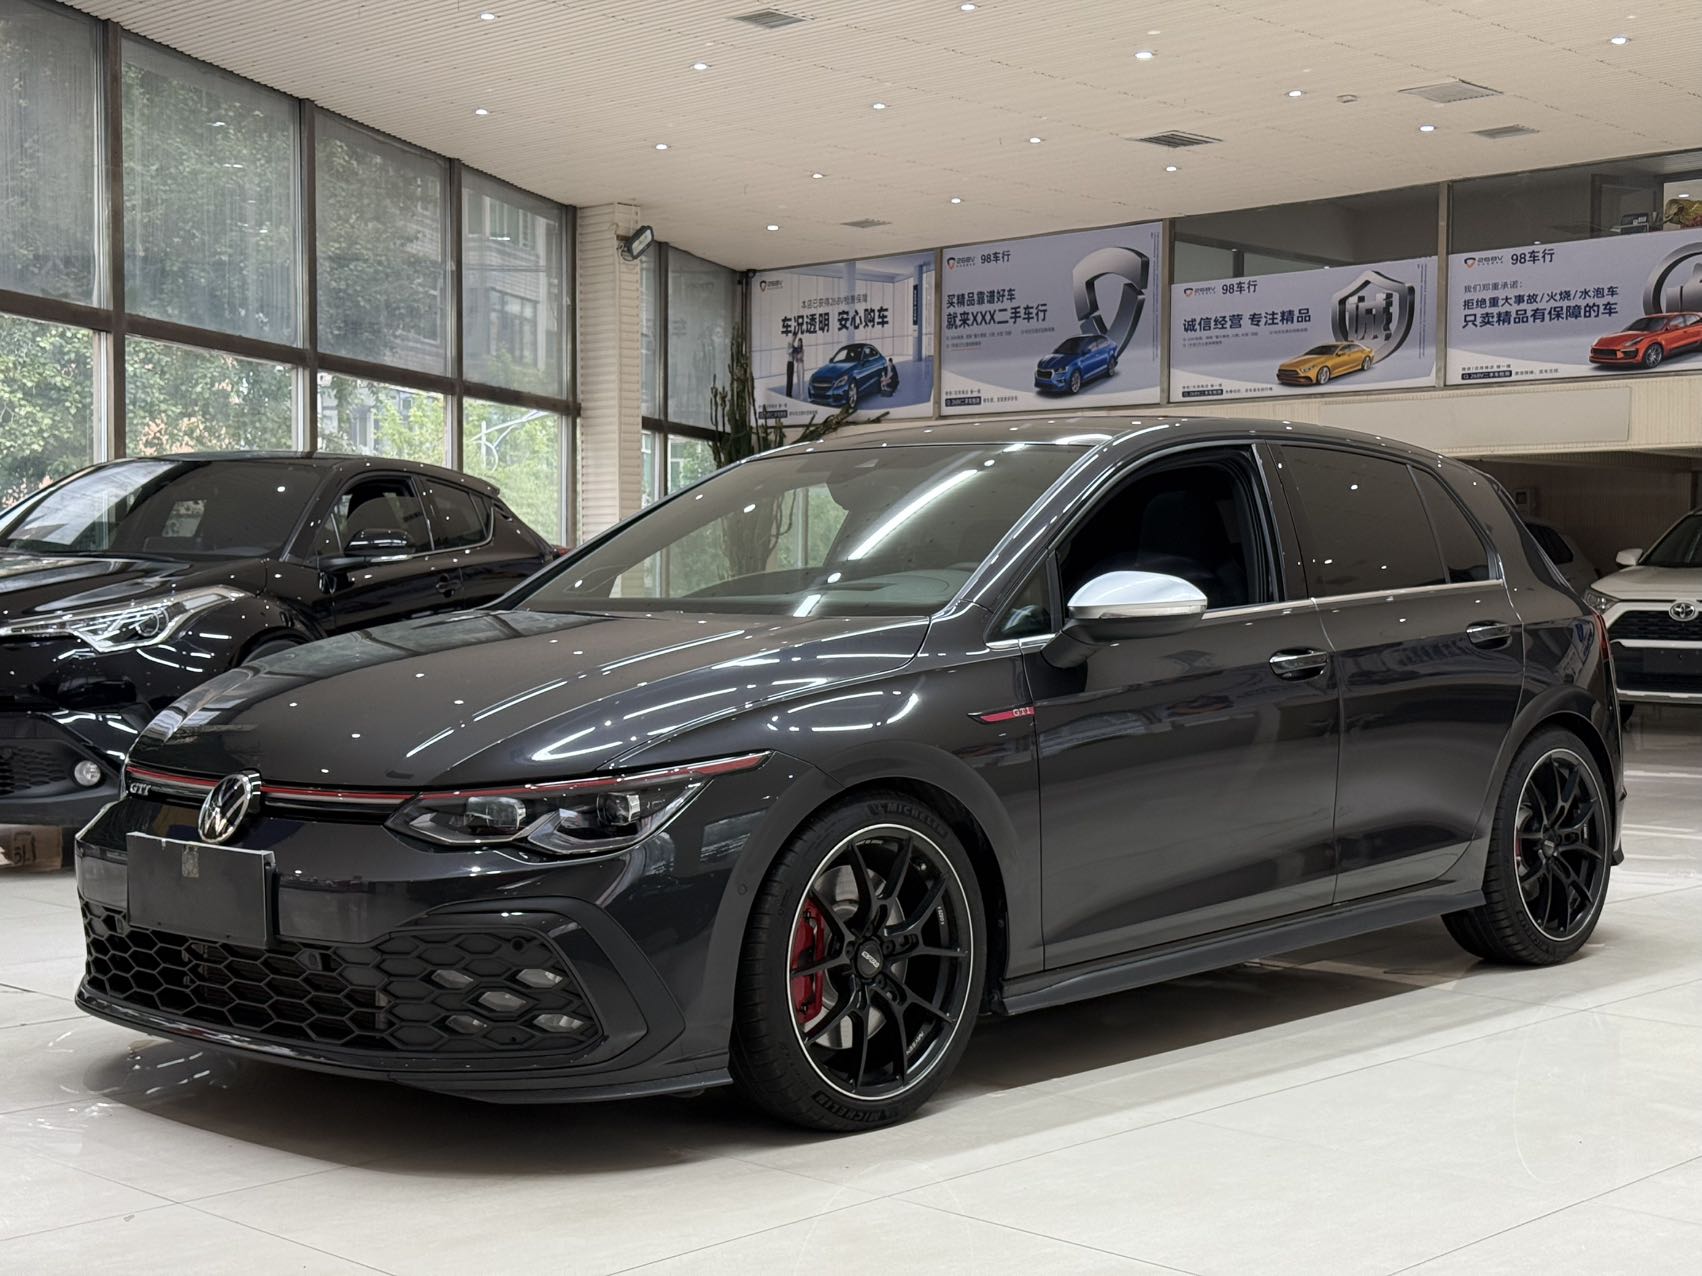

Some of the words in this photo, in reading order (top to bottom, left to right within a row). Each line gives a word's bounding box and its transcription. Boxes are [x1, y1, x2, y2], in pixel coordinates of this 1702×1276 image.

[980, 250, 1011, 264] 98车行
[1511, 248, 1555, 265] 98车行
[1221, 280, 1258, 295] 98车行
[946, 288, 1016, 309] 买精品靠谱好车
[1462, 286, 1619, 311] 拒绝重大事故/火烧/水泡车
[781, 312, 830, 337] 车况透明
[837, 306, 889, 332] 安心购车
[946, 303, 1048, 330] 就来XXX二手车行
[1183, 313, 1243, 333] 诚信经营
[1248, 308, 1311, 327] 专注精品
[1462, 302, 1619, 329] 只卖精品有保障的车
[1012, 706, 1031, 717] GTI
[129, 782, 152, 796] GTI
